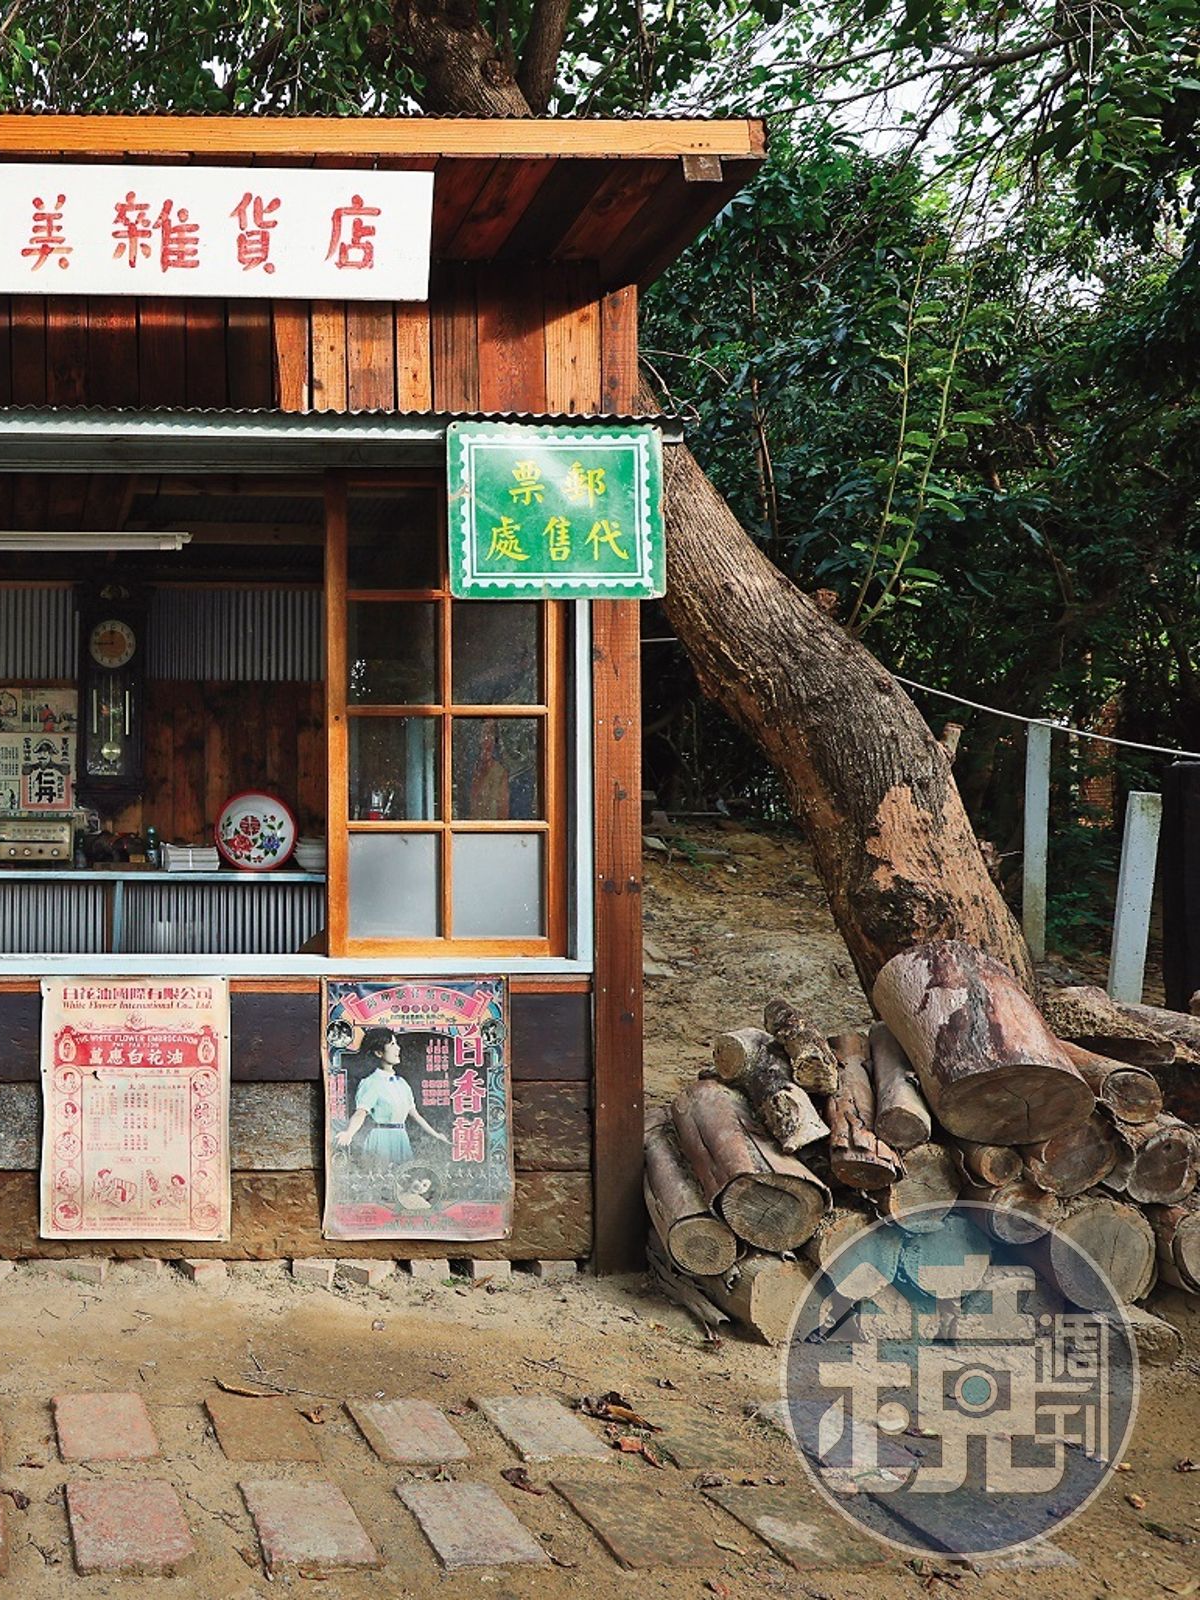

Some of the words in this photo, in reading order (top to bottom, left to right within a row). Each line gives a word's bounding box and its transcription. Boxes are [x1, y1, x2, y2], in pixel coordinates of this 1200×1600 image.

[35, 771, 57, 804] 仁丹
[63, 987, 213, 1000] 白花油國際有限公司
[63, 1000, 86, 1010] White
[89, 1000, 117, 1010] Flower
[119, 1000, 174, 1010] International
[451, 1025, 487, 1163] 白香蘭
